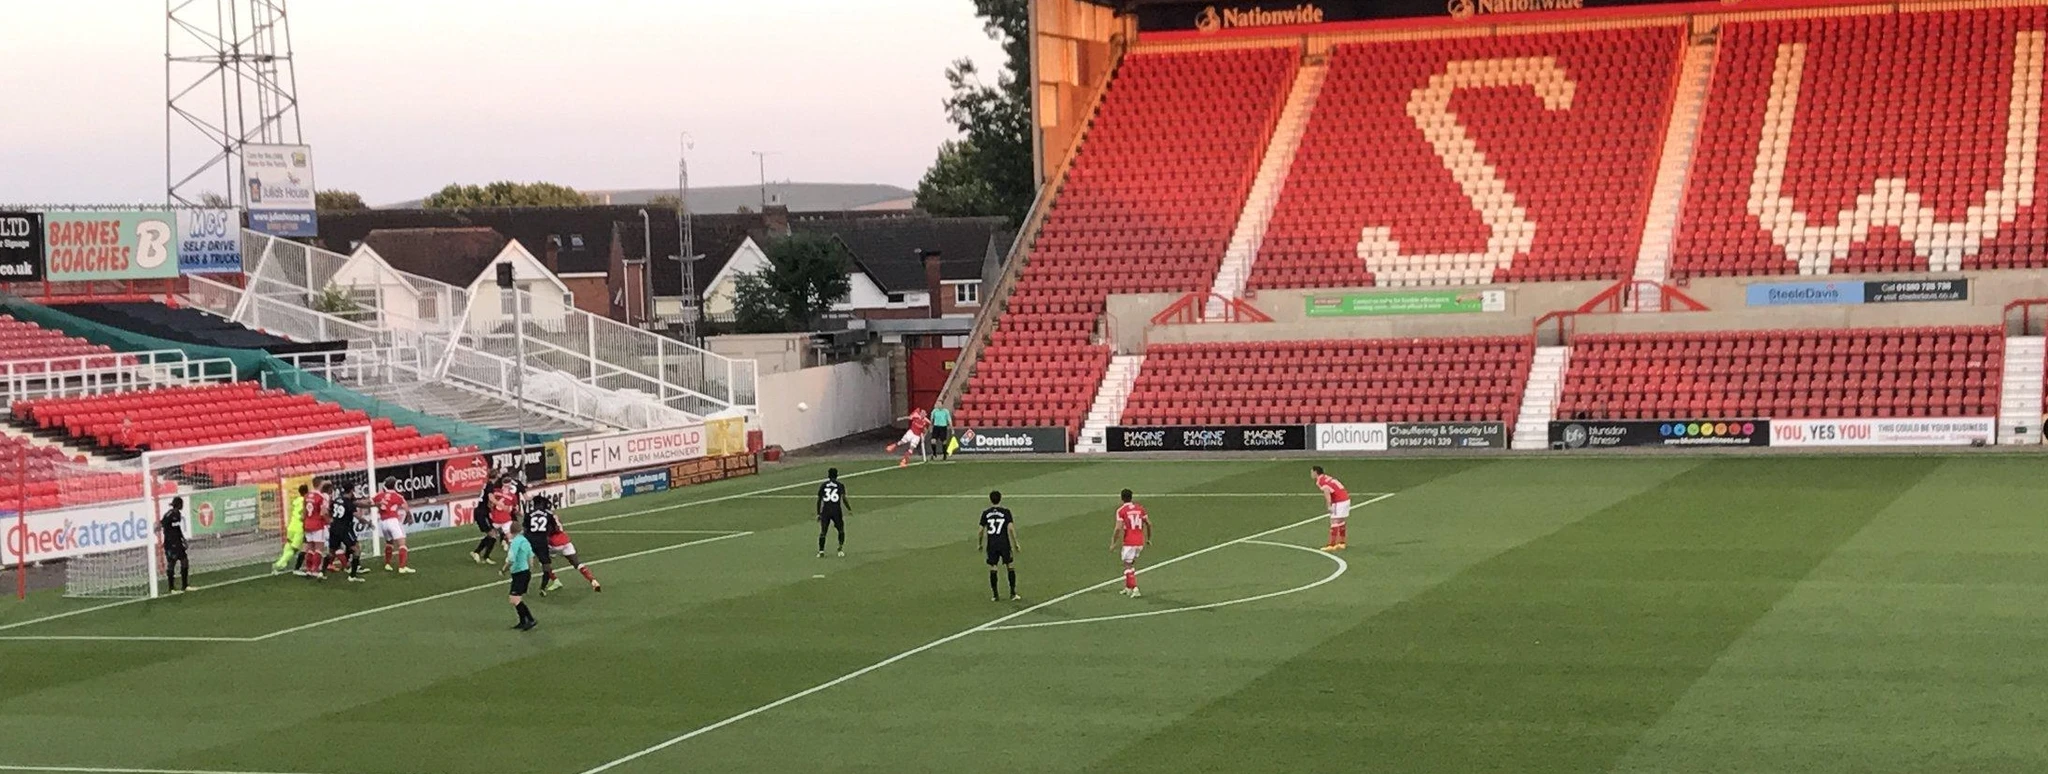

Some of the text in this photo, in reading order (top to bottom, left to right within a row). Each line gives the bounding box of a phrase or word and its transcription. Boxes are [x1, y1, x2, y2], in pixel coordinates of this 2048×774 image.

[1224, 4, 1323, 28] Nationwide
[49, 220, 120, 246] BARNES
[136, 220, 171, 268] B
[183, 240, 206, 252] SELF
[50, 246, 130, 274] COACHES
[1322, 426, 1384, 449] platinum
[1484, 426, 1498, 434] Ltd
[1774, 425, 1806, 442] YOU,
[1810, 424, 1836, 440] YES
[1838, 424, 1872, 440] YOU!
[627, 431, 700, 453] COTSWOLD
[976, 434, 1034, 447] Domino's
[1124, 439, 1164, 447] CRUISING
[1184, 439, 1224, 447] CRUISING
[492, 453, 512, 469] Fill
[823, 488, 840, 502] 36
[530, 516, 548, 532] 52
[987, 518, 1006, 534] 37
[1128, 514, 1142, 530] 14
[7, 510, 148, 556] Checkatrade
